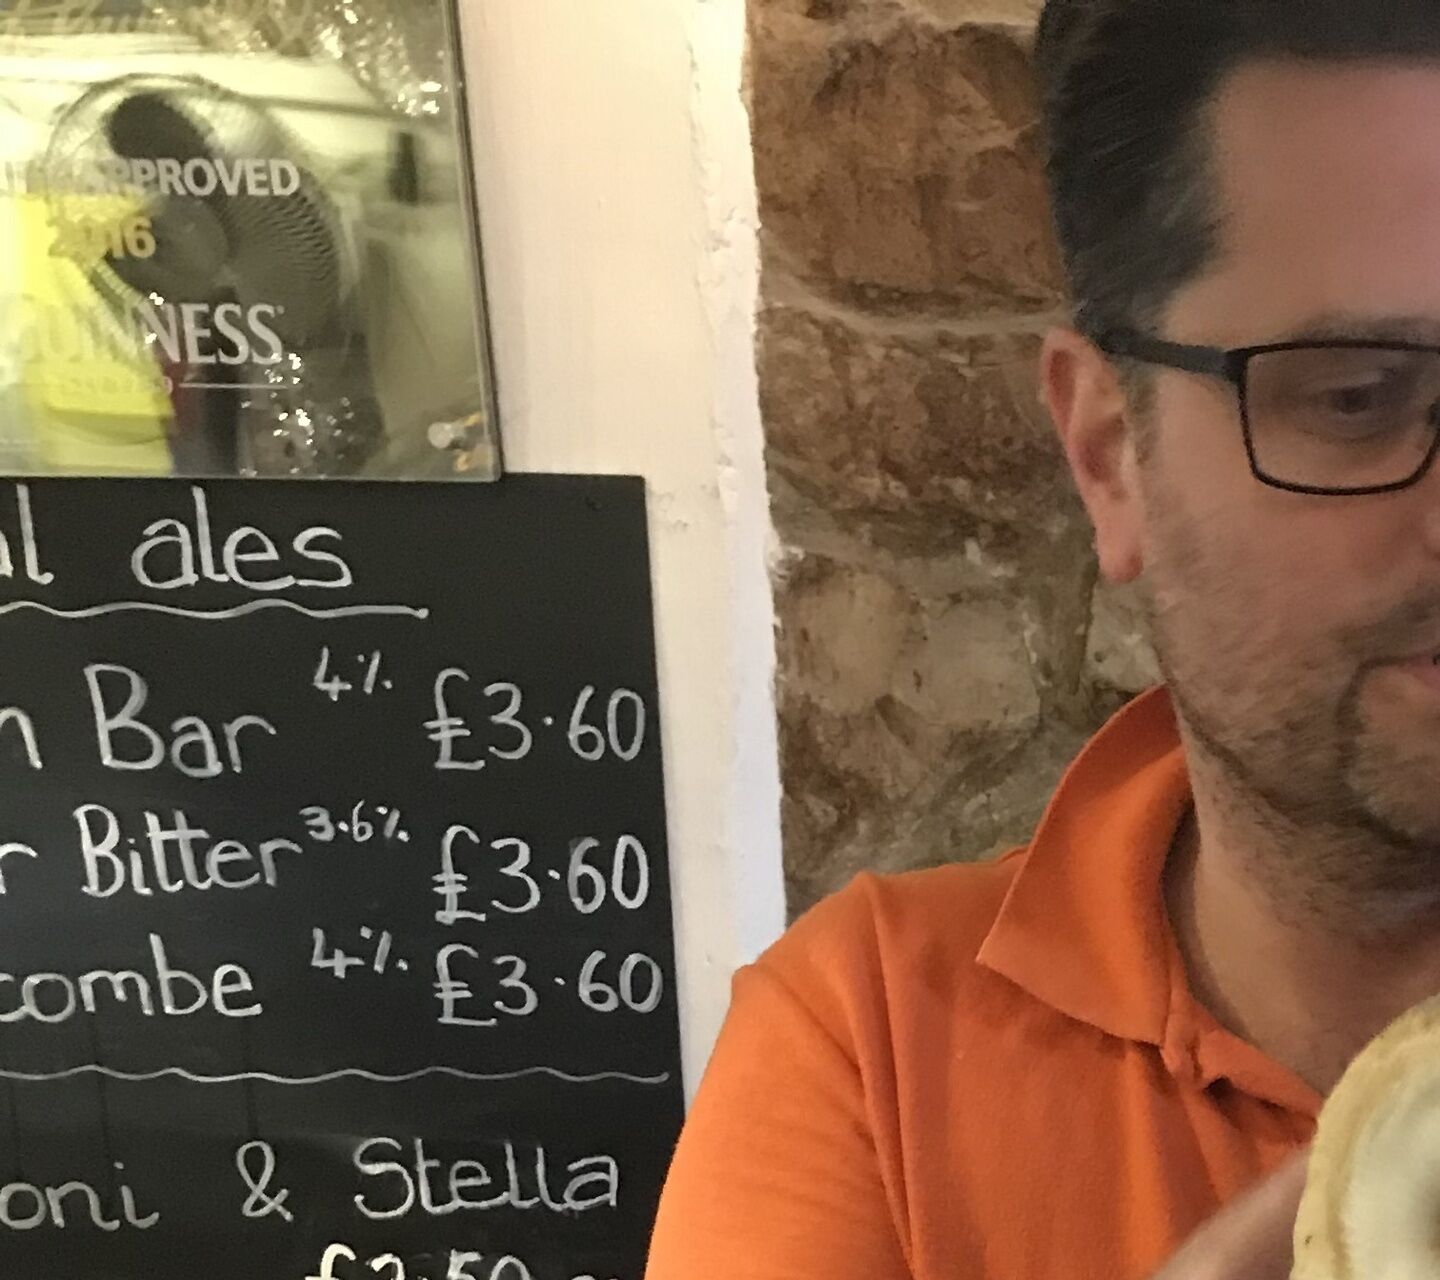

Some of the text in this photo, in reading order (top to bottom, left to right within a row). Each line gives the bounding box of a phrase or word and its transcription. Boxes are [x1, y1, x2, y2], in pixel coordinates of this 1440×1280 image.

[131, 484, 353, 589] ales
[84, 663, 277, 778] Bar
[424, 667, 646, 770] £3.60
[73, 803, 302, 898] Bitter
[432, 825, 651, 924] £3.60
[433, 943, 664, 1027] £3.60
[0, 1137, 619, 1231] oni & Stella
